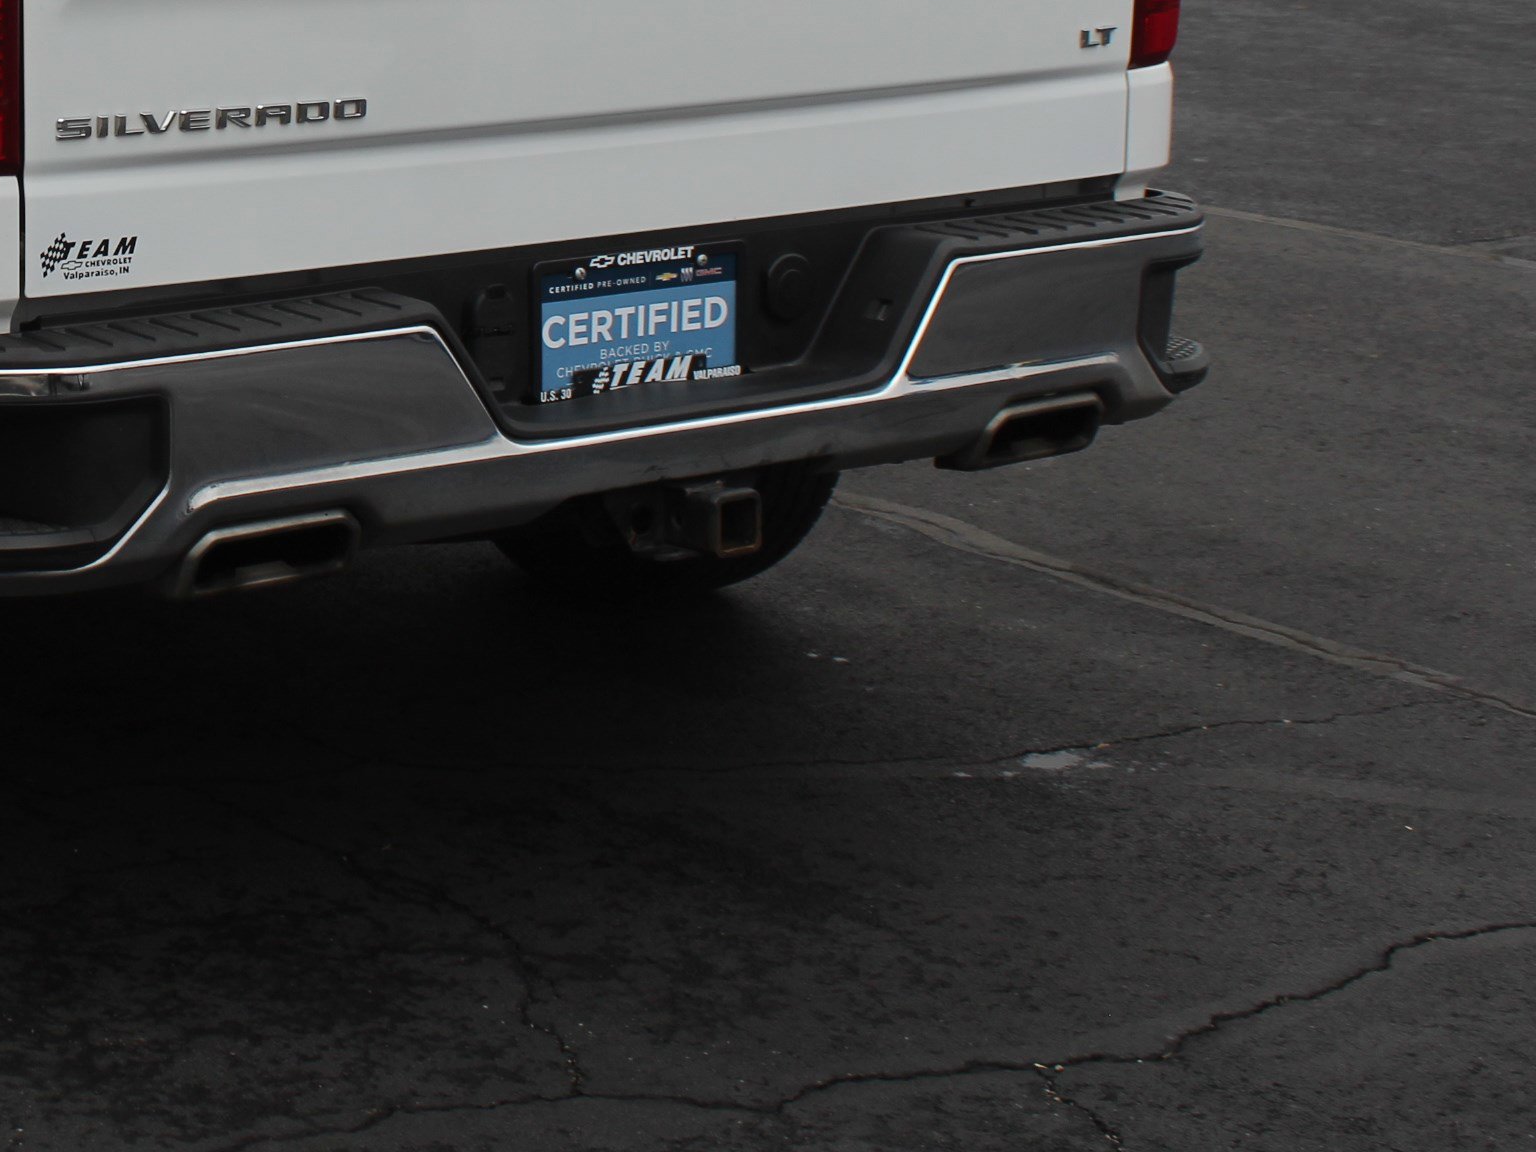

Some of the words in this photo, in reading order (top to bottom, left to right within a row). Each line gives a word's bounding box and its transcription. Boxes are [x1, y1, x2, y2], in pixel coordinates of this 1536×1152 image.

[1079, 25, 1118, 49] LT
[55, 97, 368, 142] SILVERADO
[64, 236, 138, 260] TEAM
[617, 246, 695, 266] CHEVROLET
[84, 257, 132, 268] CHEVROLET
[64, 269, 118, 280] Valparaiso,
[119, 266, 130, 274] IN
[548, 282, 594, 294] CERTIFIED
[596, 276, 647, 288] PRE-OWNED
[541, 296, 729, 349] CERTIFIED
[600, 343, 649, 360] BACKED
[654, 341, 670, 352] BY
[609, 354, 693, 388] TEAM
[693, 364, 742, 381] VALPARAISO
[540, 390, 559, 403] U.S.
[560, 388, 572, 400] 30
